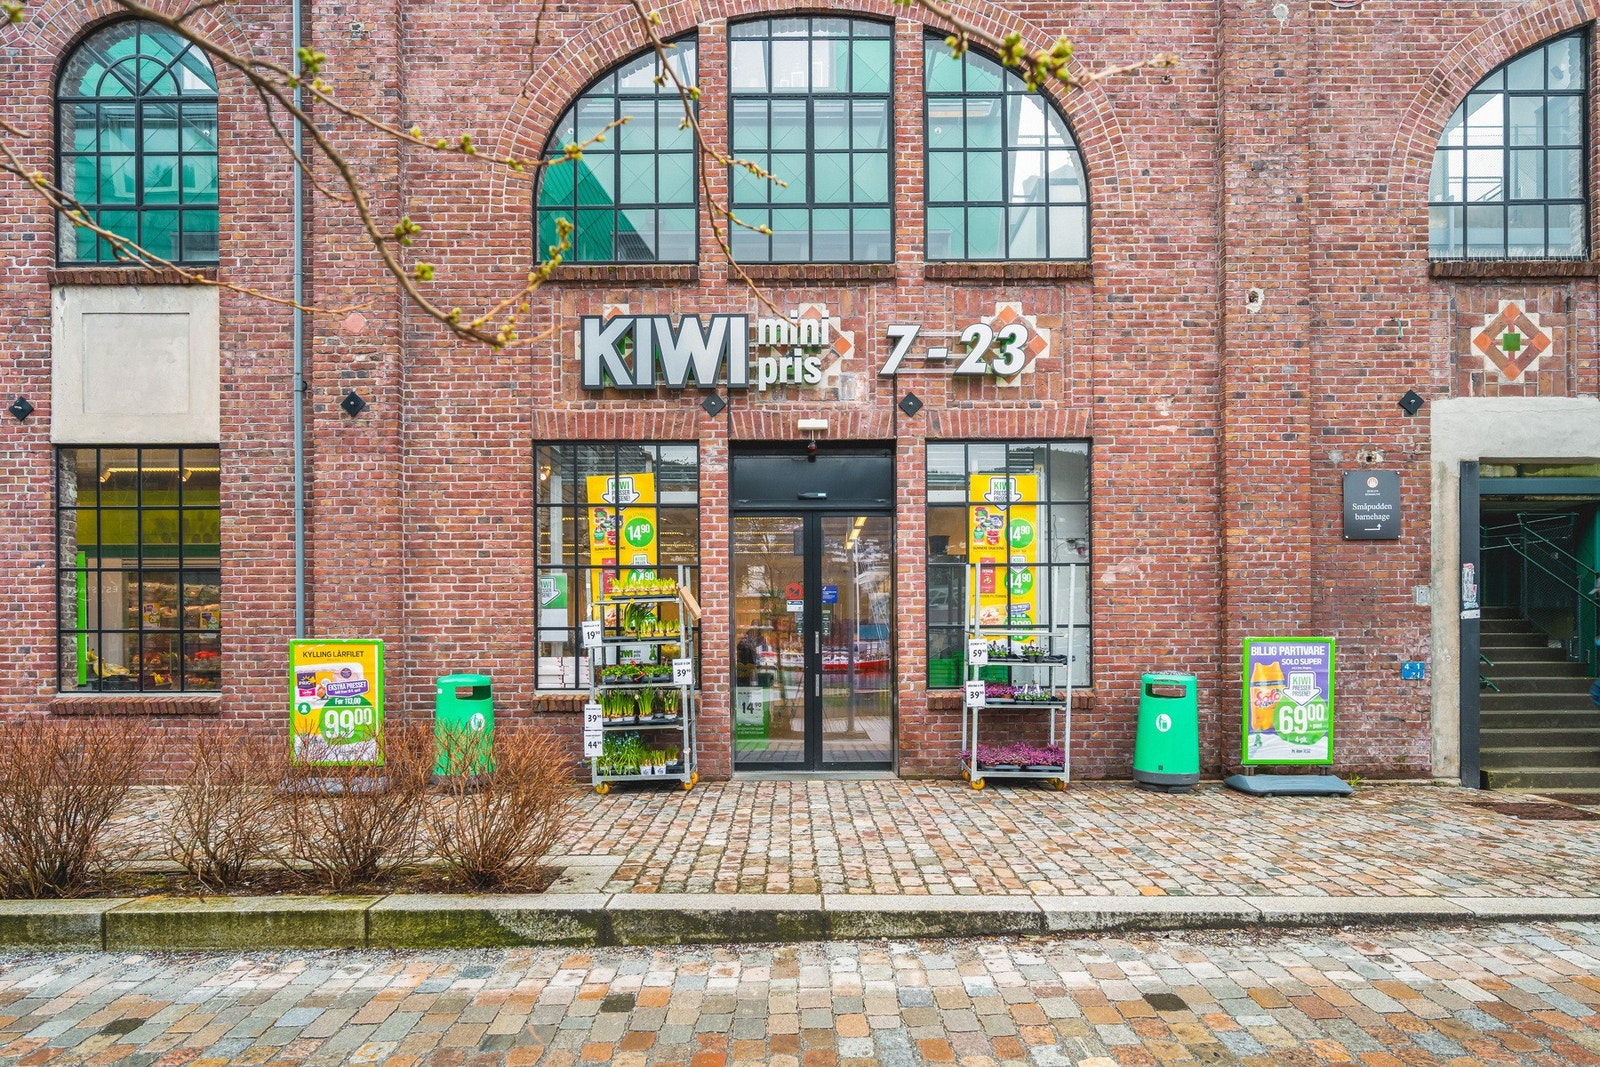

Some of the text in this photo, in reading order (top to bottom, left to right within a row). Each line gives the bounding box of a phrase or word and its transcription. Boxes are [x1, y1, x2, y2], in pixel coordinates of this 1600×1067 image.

[758, 311, 830, 346] mini
[580, 314, 749, 390] KIWI
[758, 348, 822, 391] pris
[1352, 503, 1392, 511] Småpudden
[1355, 513, 1390, 521] barnehage
[1251, 646, 1325, 656] BILLIG PARTIVARE
